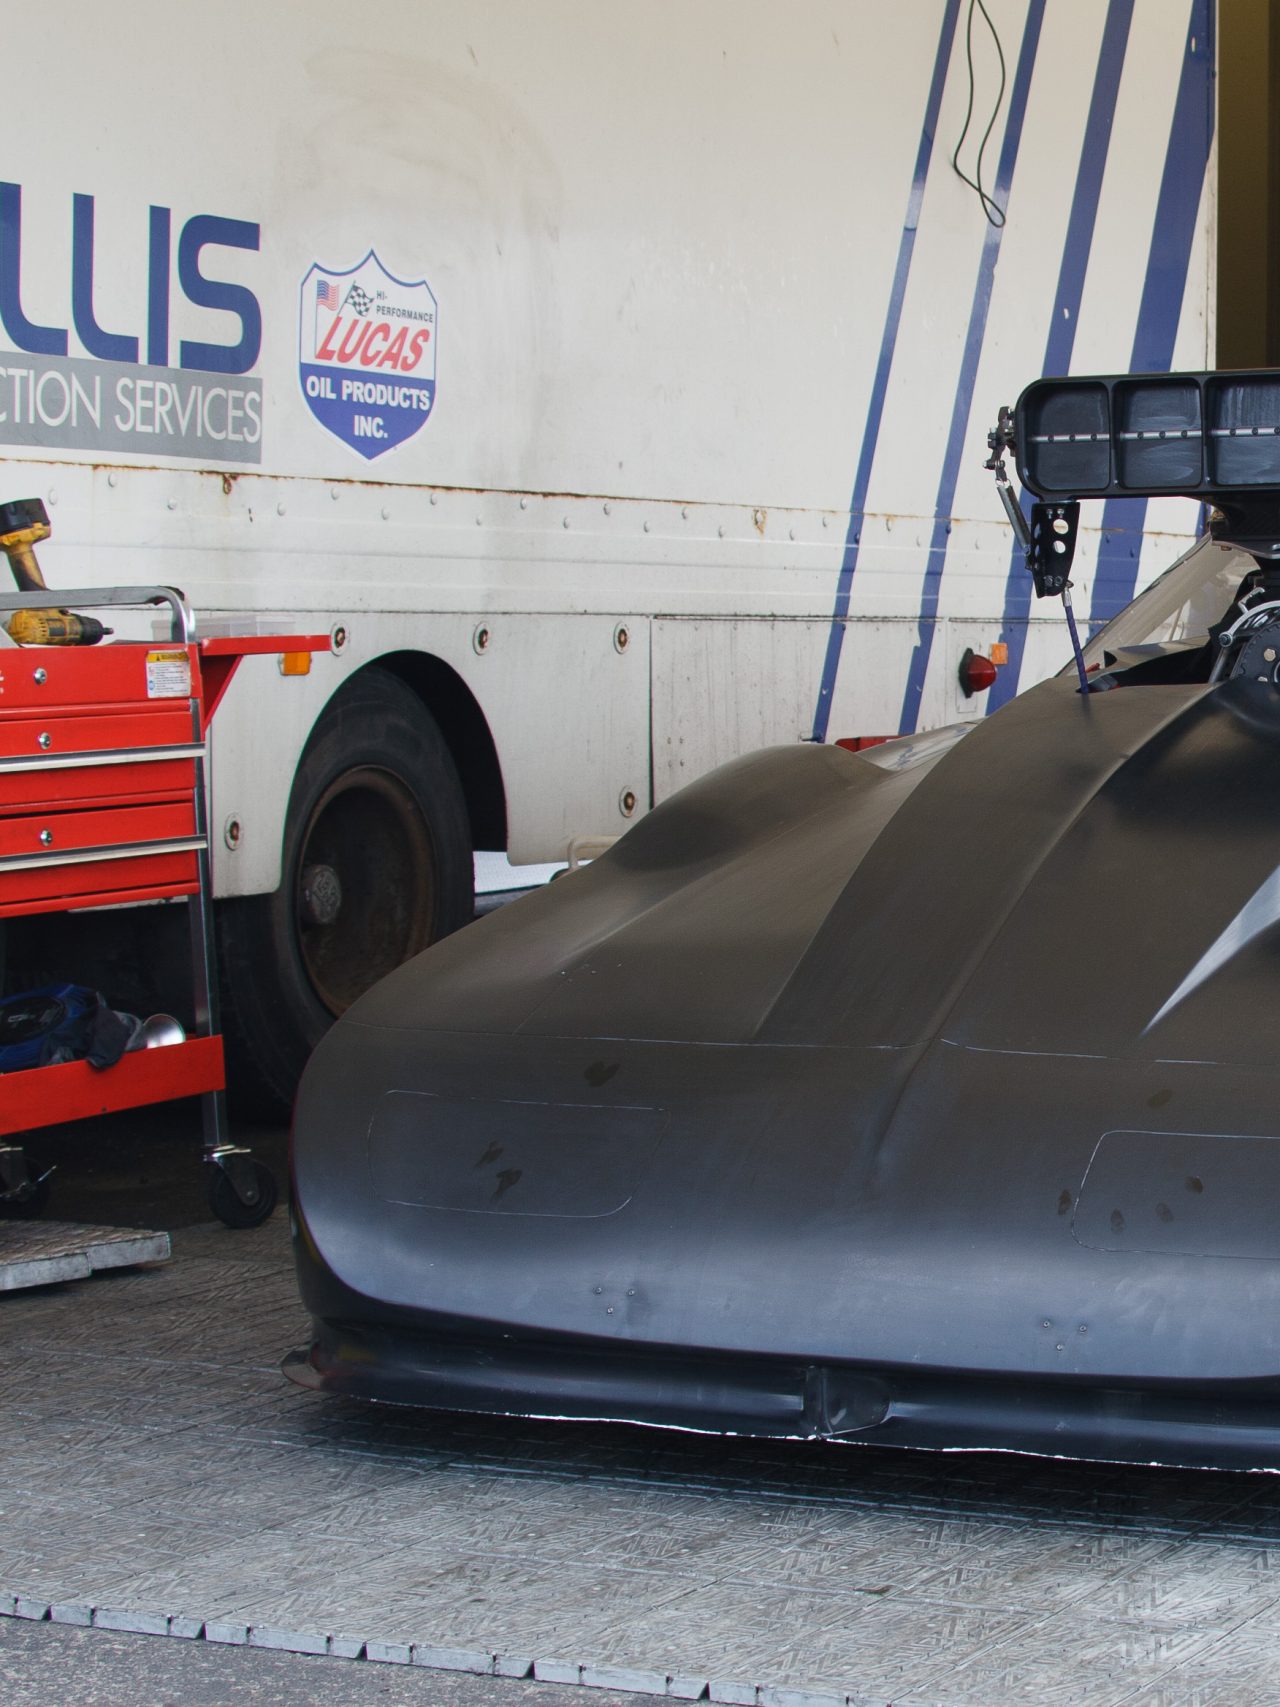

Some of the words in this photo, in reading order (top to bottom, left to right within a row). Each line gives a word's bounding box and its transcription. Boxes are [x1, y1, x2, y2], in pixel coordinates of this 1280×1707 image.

[376, 290, 388, 300] HI-
[376, 305, 434, 323] PERFORMANCE
[315, 316, 430, 372] LUCAS
[306, 375, 337, 400] OIL
[342, 379, 431, 411] PRODUCTS
[114, 376, 261, 443] SERVICES
[353, 415, 388, 438] INC.
